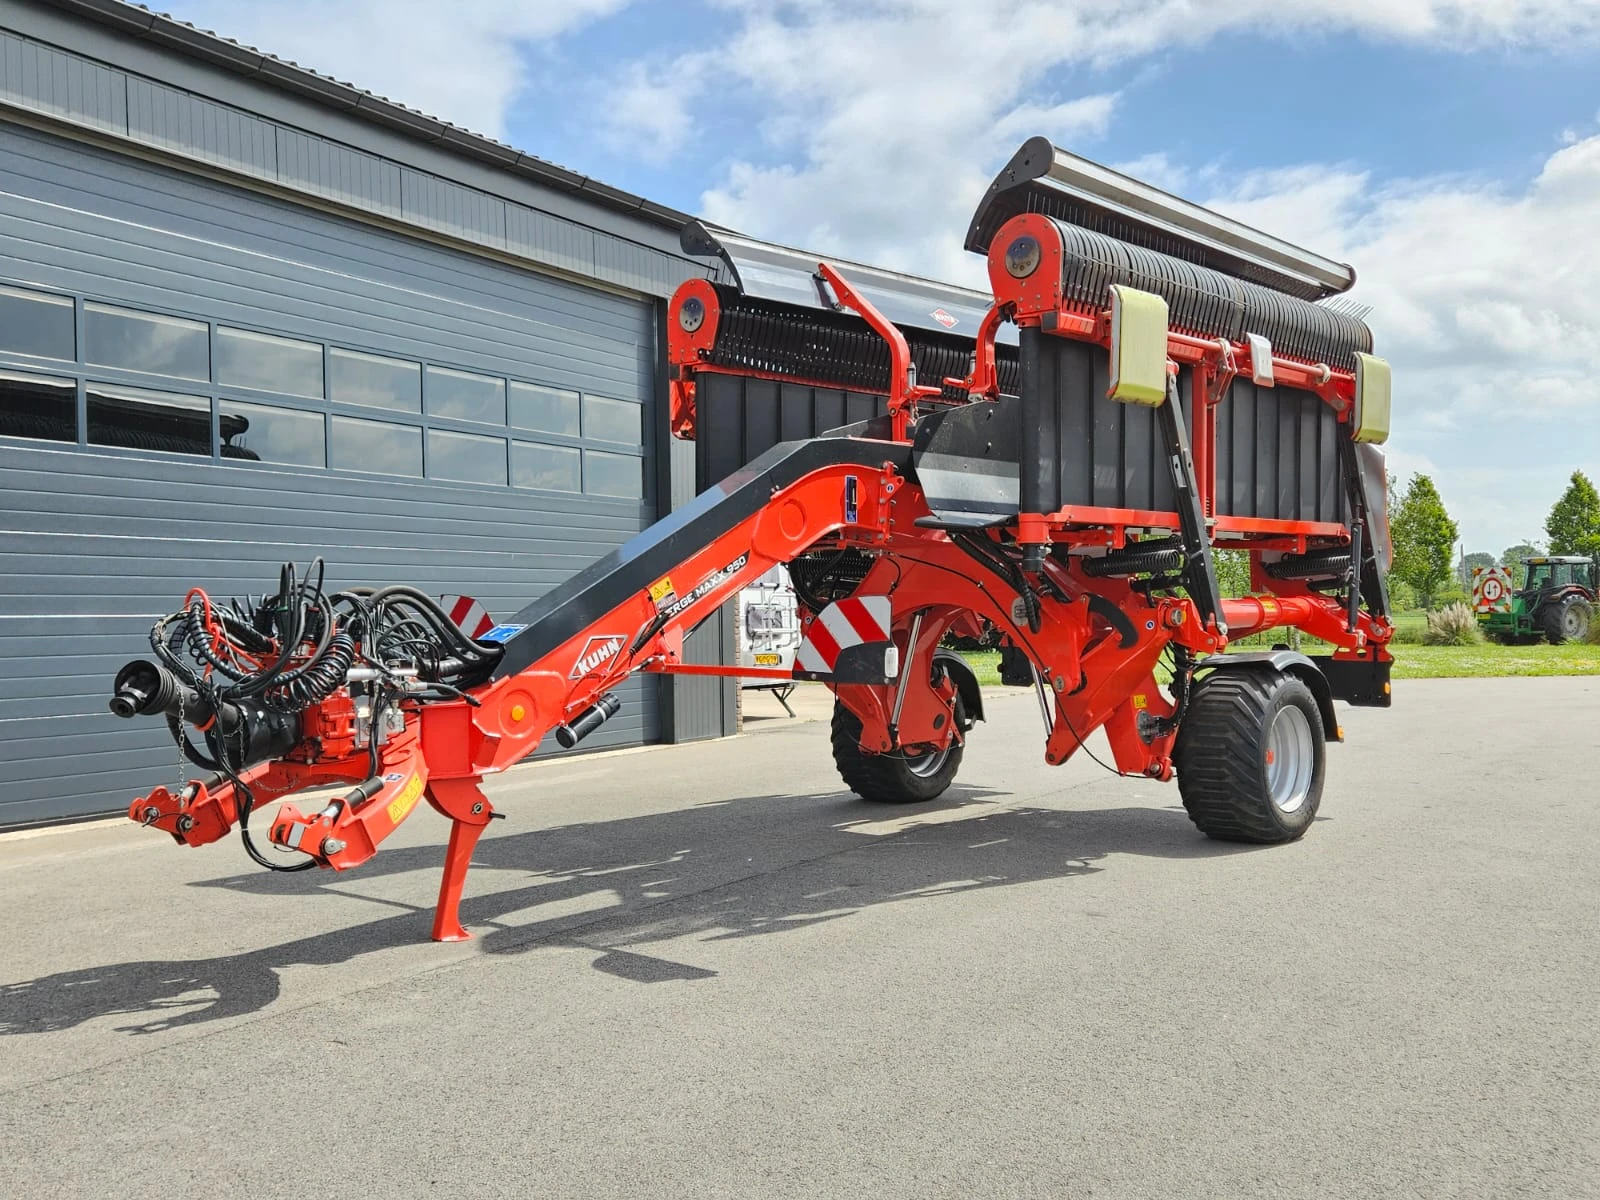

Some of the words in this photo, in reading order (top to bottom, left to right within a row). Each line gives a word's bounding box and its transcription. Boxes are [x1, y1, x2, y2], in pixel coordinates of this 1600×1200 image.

[663, 592, 695, 617] ERGE
[695, 570, 726, 597] MAXX
[726, 555, 746, 574] 950
[577, 638, 620, 676] KUHN
